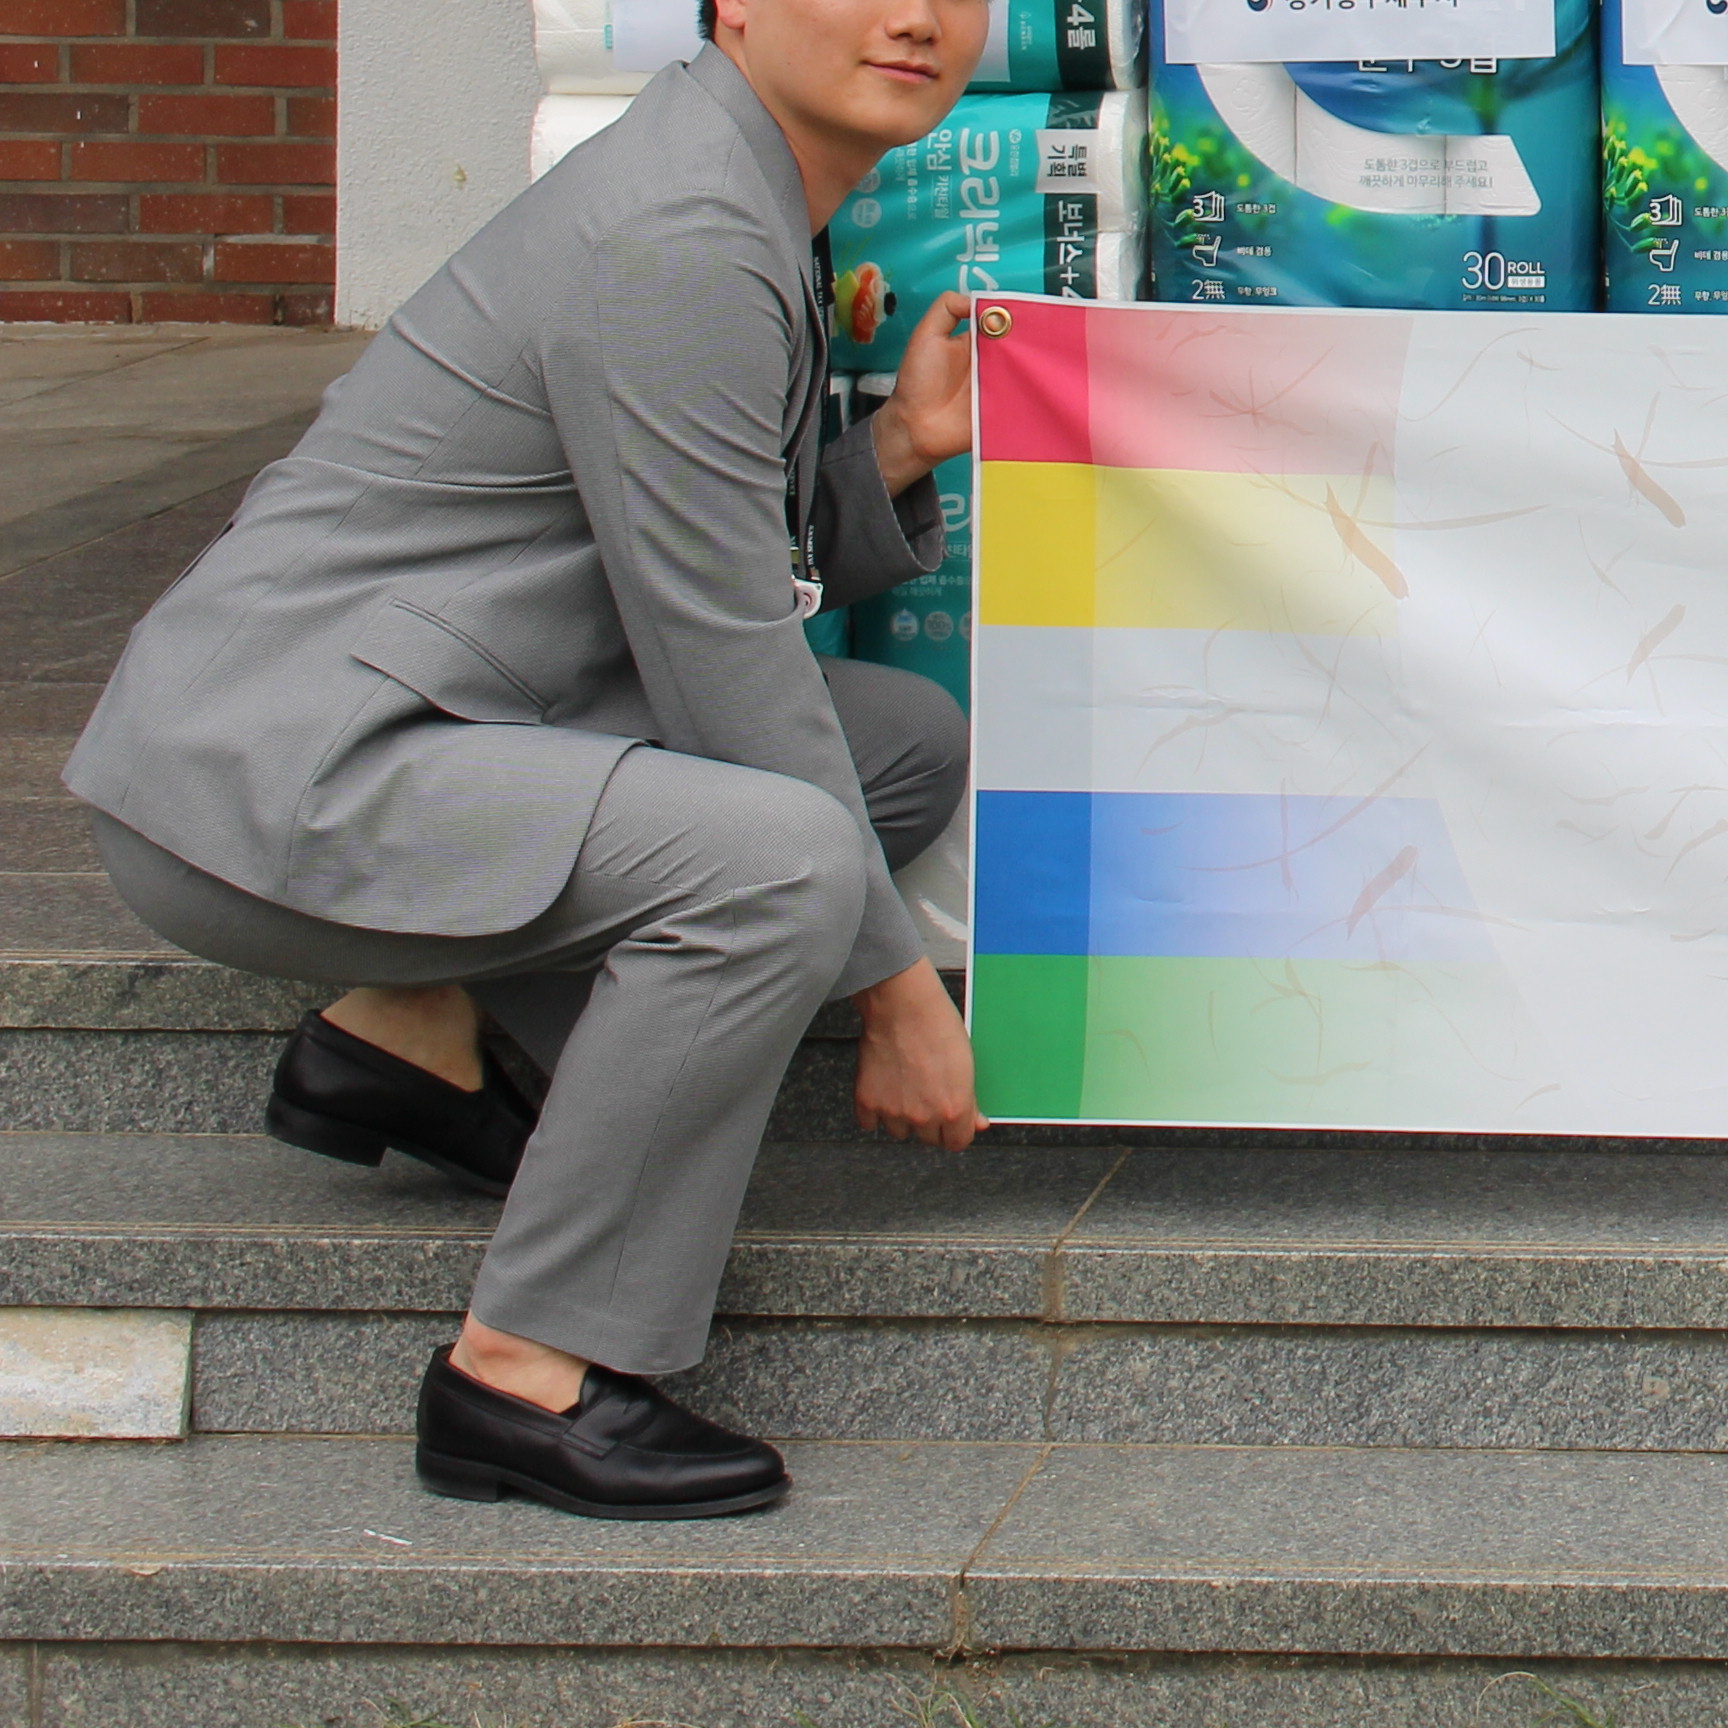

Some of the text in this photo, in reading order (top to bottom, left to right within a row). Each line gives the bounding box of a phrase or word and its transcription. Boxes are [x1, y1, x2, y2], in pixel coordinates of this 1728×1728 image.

[926, 129, 953, 171] 안심
[1047, 144, 1067, 178] 기획
[1069, 143, 1088, 177] 특별
[1364, 158, 1488, 173] 도톰한 3겹으로 부드럽고
[1359, 174, 1494, 189] 깨끗하게 마무리해 주세요!
[1461, 250, 1506, 292] 30
[1507, 261, 1546, 275] ROLL
